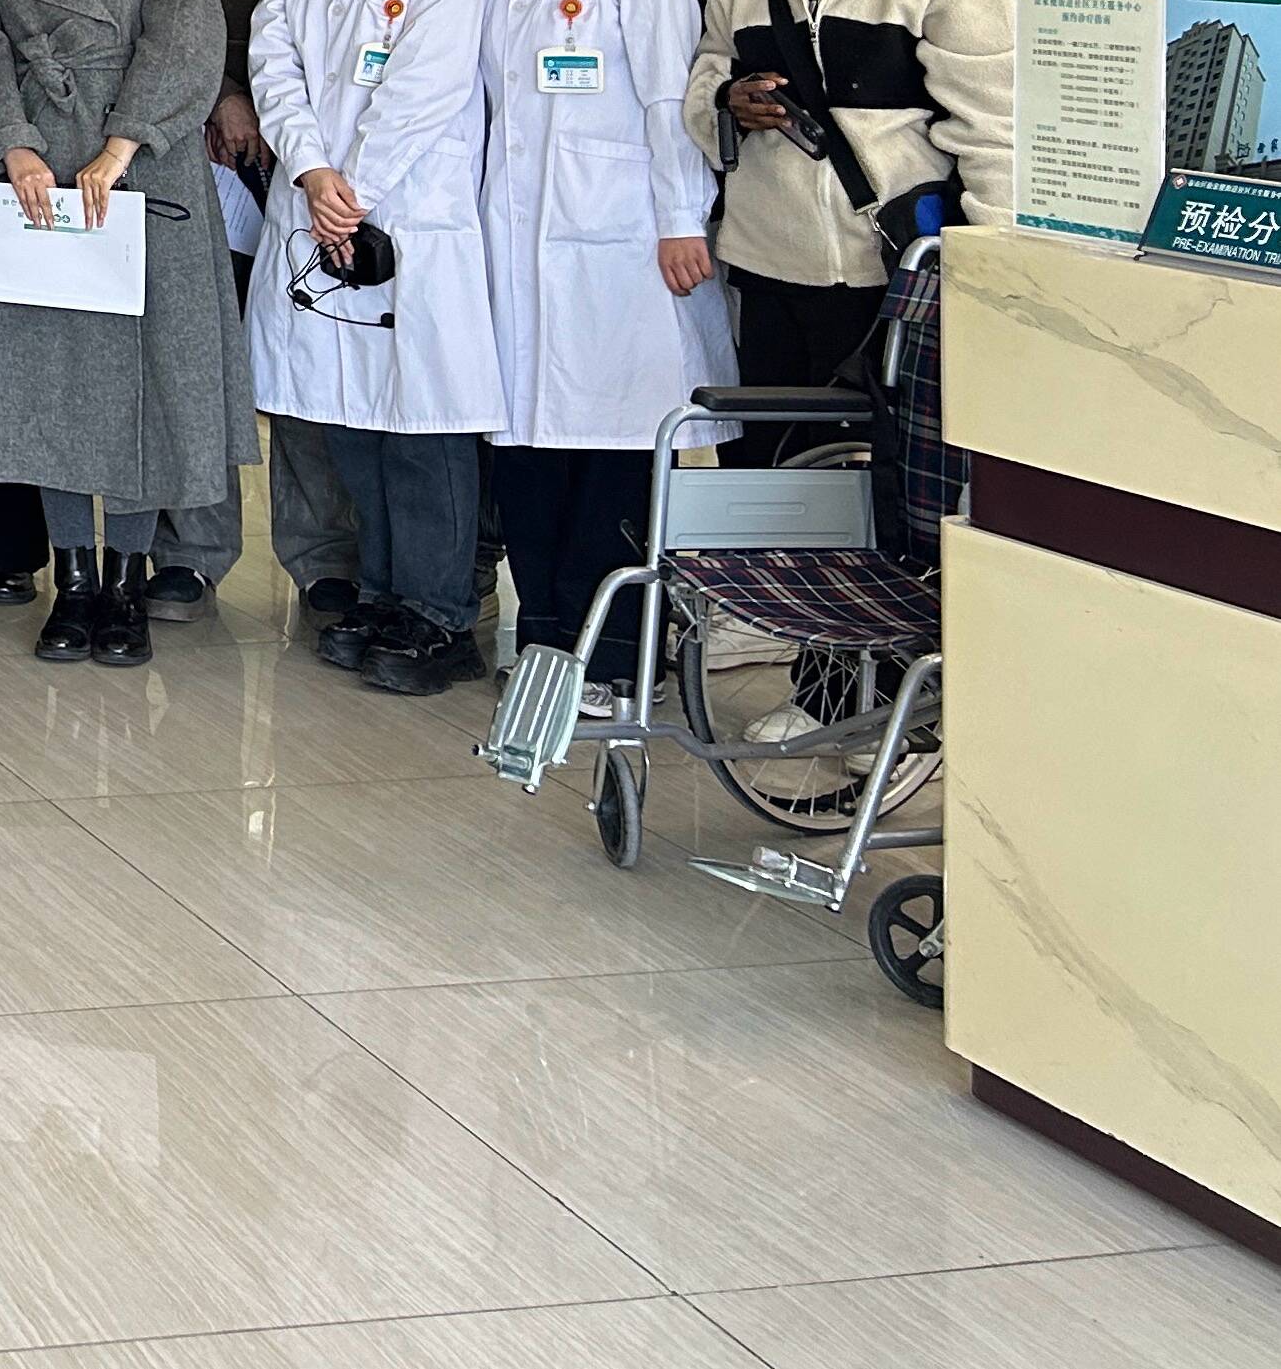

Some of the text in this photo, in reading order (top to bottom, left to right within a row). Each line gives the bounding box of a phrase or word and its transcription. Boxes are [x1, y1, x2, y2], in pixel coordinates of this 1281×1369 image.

[1177, 199, 1281, 246] 预检分
[1172, 236, 1262, 262] PRE-EXAMINATION
